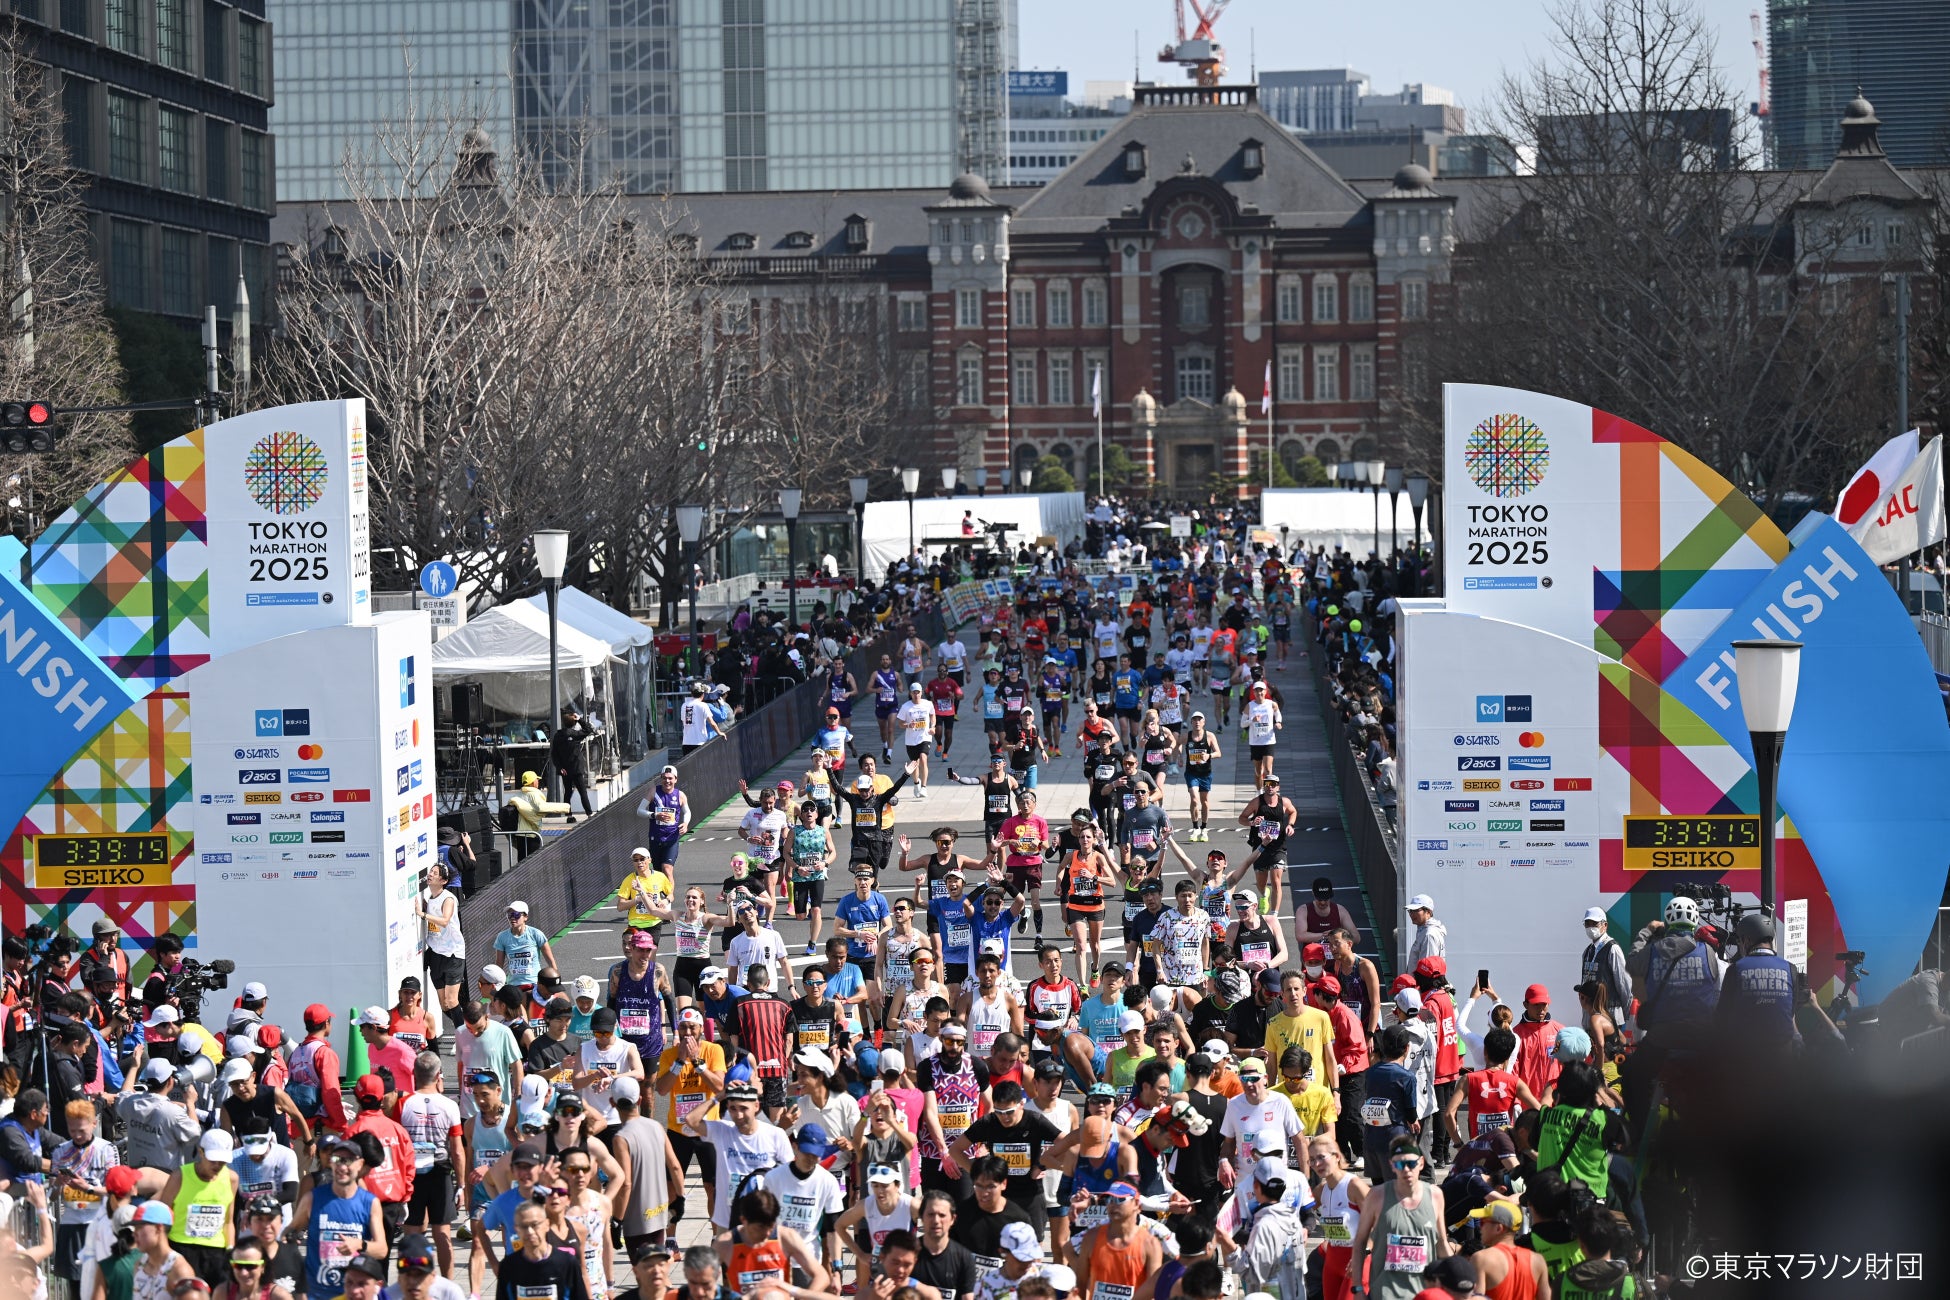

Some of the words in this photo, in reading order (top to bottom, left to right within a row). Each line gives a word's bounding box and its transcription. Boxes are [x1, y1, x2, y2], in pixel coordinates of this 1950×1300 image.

[1467, 504, 1549, 523] TOKYO
[248, 521, 328, 540] TOKYO
[1468, 526, 1548, 538] MARATHON
[250, 542, 327, 554] MARATHON
[1468, 540, 1549, 565] 2025
[249, 556, 329, 581] 2025
[1472, 760, 1496, 768] asics
[254, 772, 277, 782] asics
[245, 794, 281, 802] SEIKO
[1531, 802, 1561, 810] Salonpas
[311, 814, 342, 822] Salonpas
[1489, 822, 1521, 830] バスクリン
[271, 834, 302, 842] バスクリン
[1417, 841, 1447, 849] 日本光電
[202, 854, 232, 863] 日本光電
[1652, 850, 1735, 868] SEIKO
[63, 868, 144, 886] SEIKO
[1740, 968, 1789, 980] SPONSOR
[1741, 978, 1789, 991] CAMERA
[805, 1030, 826, 1041] 22195
[943, 1114, 967, 1126] 25088
[129, 1119, 164, 1136] OFFICIAL
[1002, 1153, 1025, 1165] 4201
[325, 1220, 363, 1232] WaterAid
[1106, 1286, 1131, 1295] 東京メトロ
